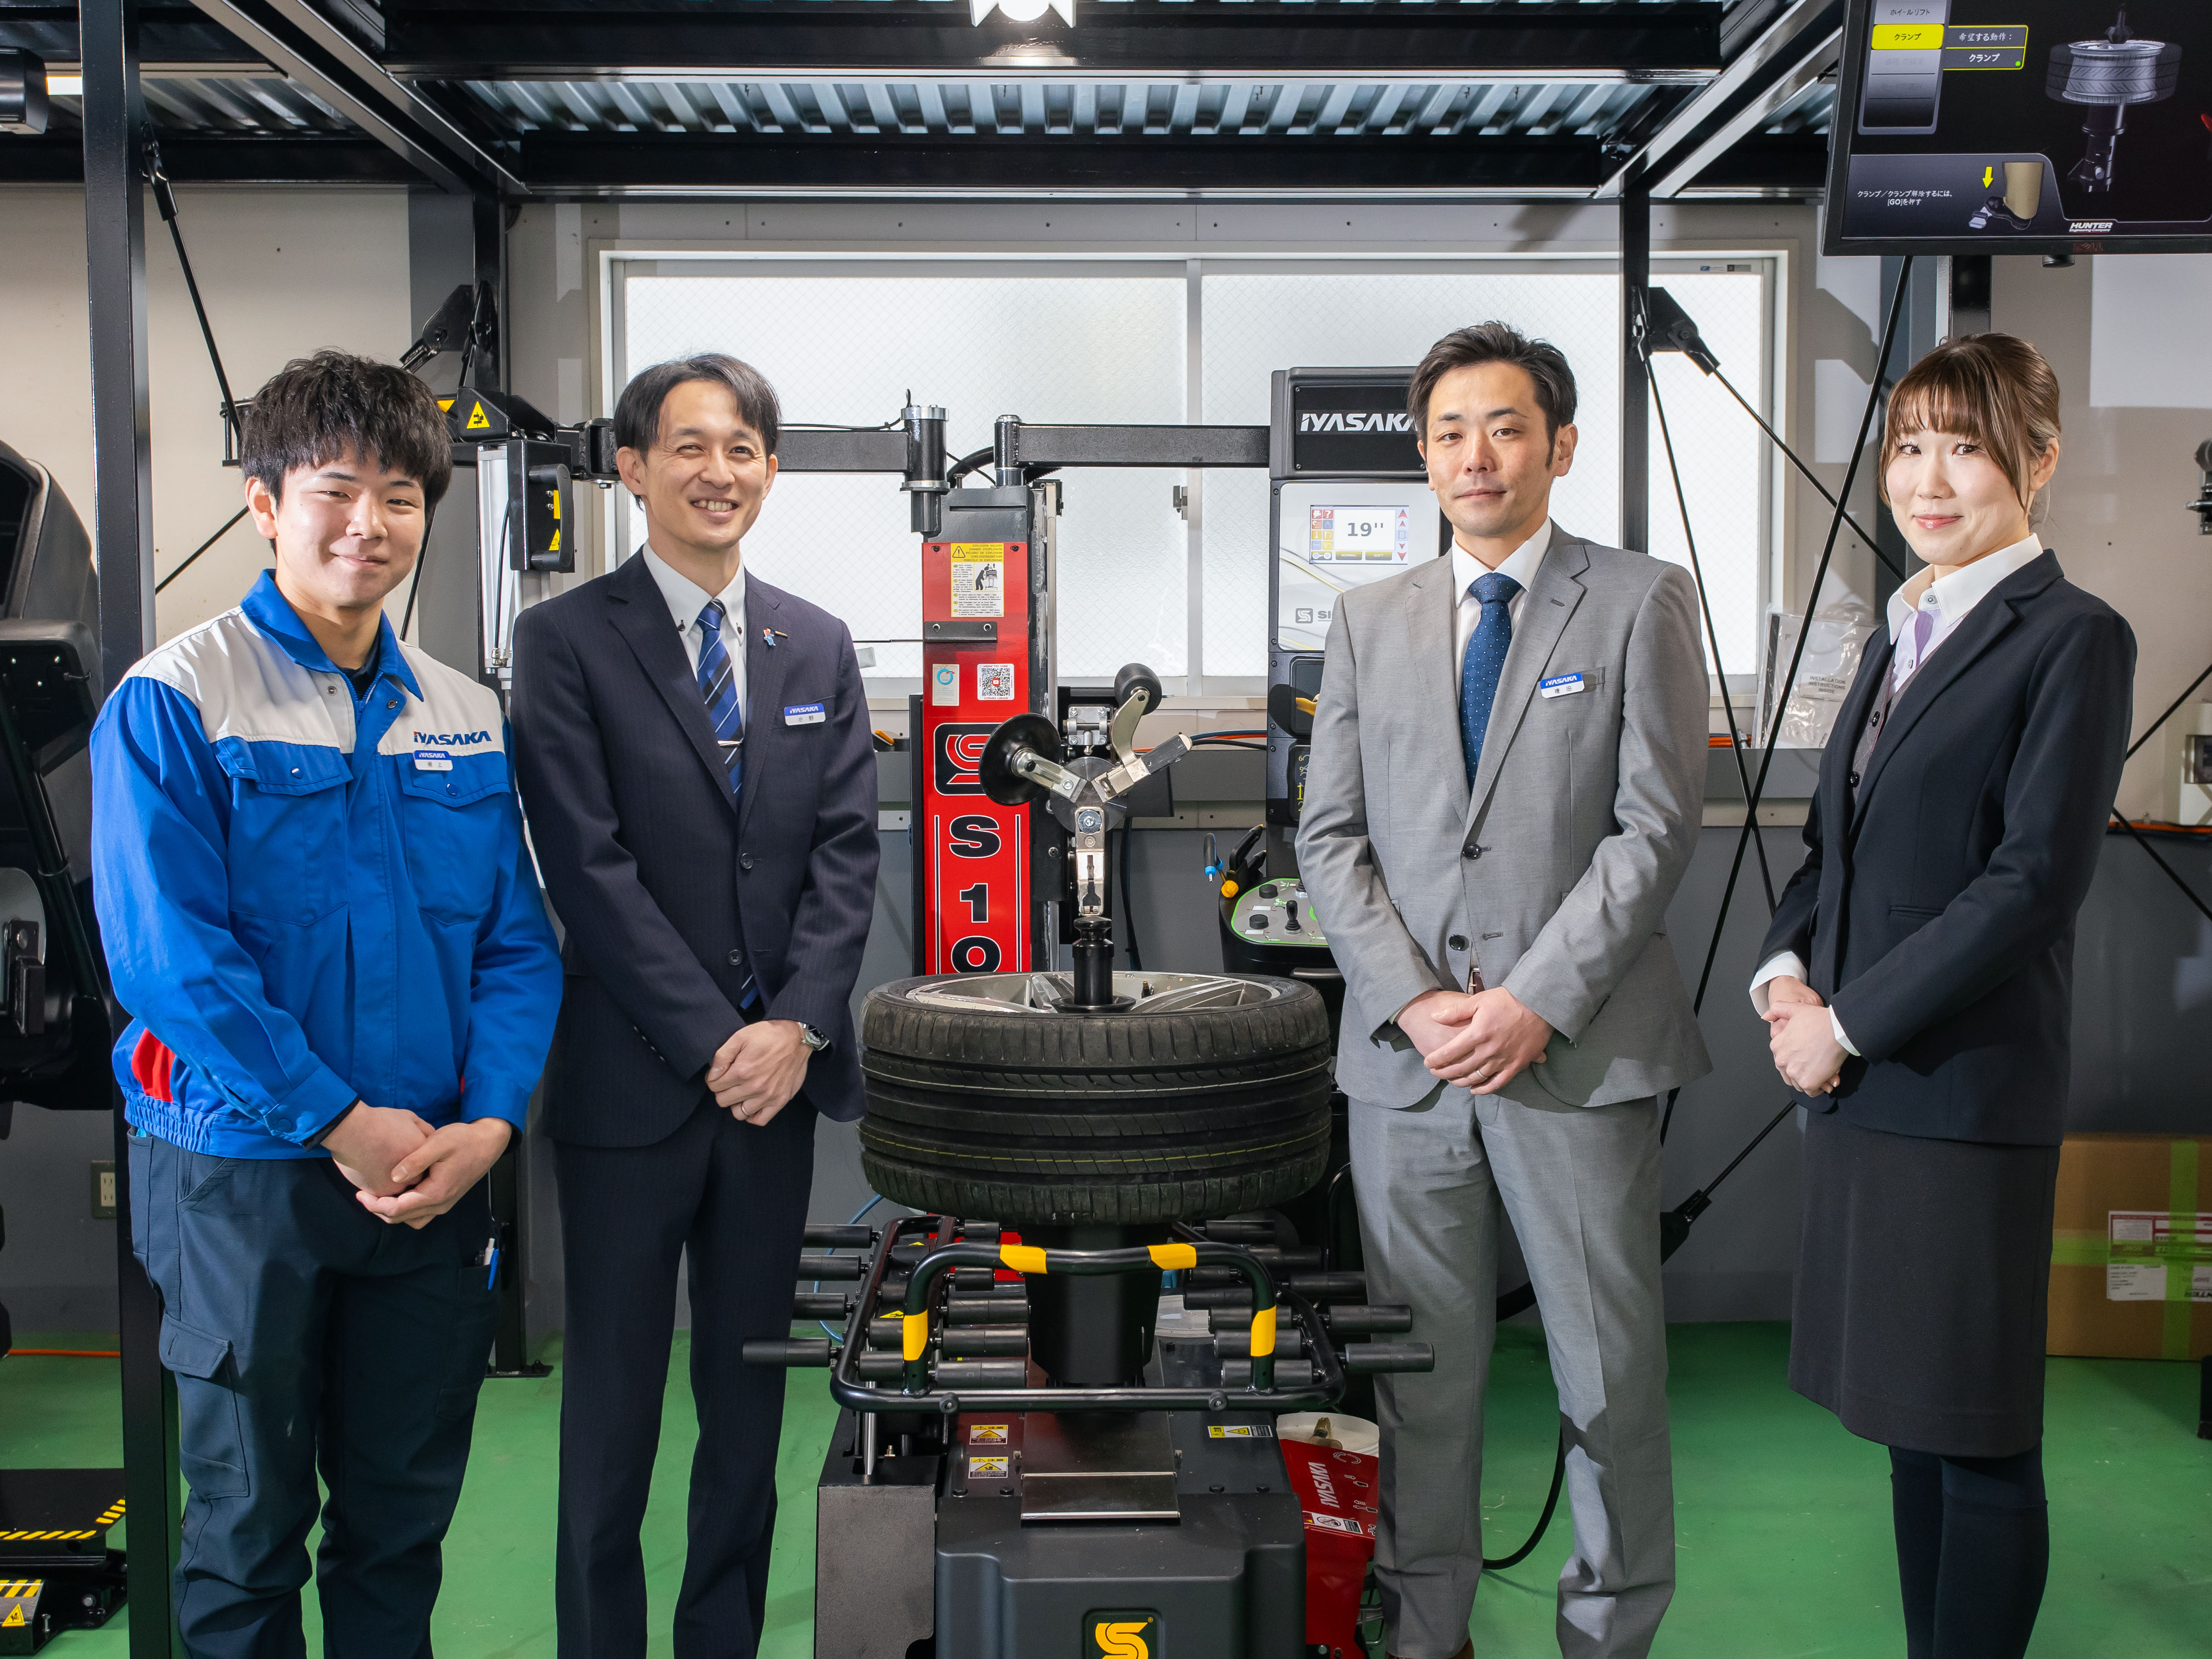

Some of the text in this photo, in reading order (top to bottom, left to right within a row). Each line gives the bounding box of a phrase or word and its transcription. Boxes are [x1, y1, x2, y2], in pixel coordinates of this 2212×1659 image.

[1968, 54, 2000, 62] クランプ
[1545, 675, 1577, 686] IYASAKA
[1809, 676, 1846, 684] INSTALLATION
[1808, 681, 1845, 690] INSTRUCTIONS
[413, 730, 493, 745] IYASAKA
[1308, 1462, 1340, 1508] IYASAKA
